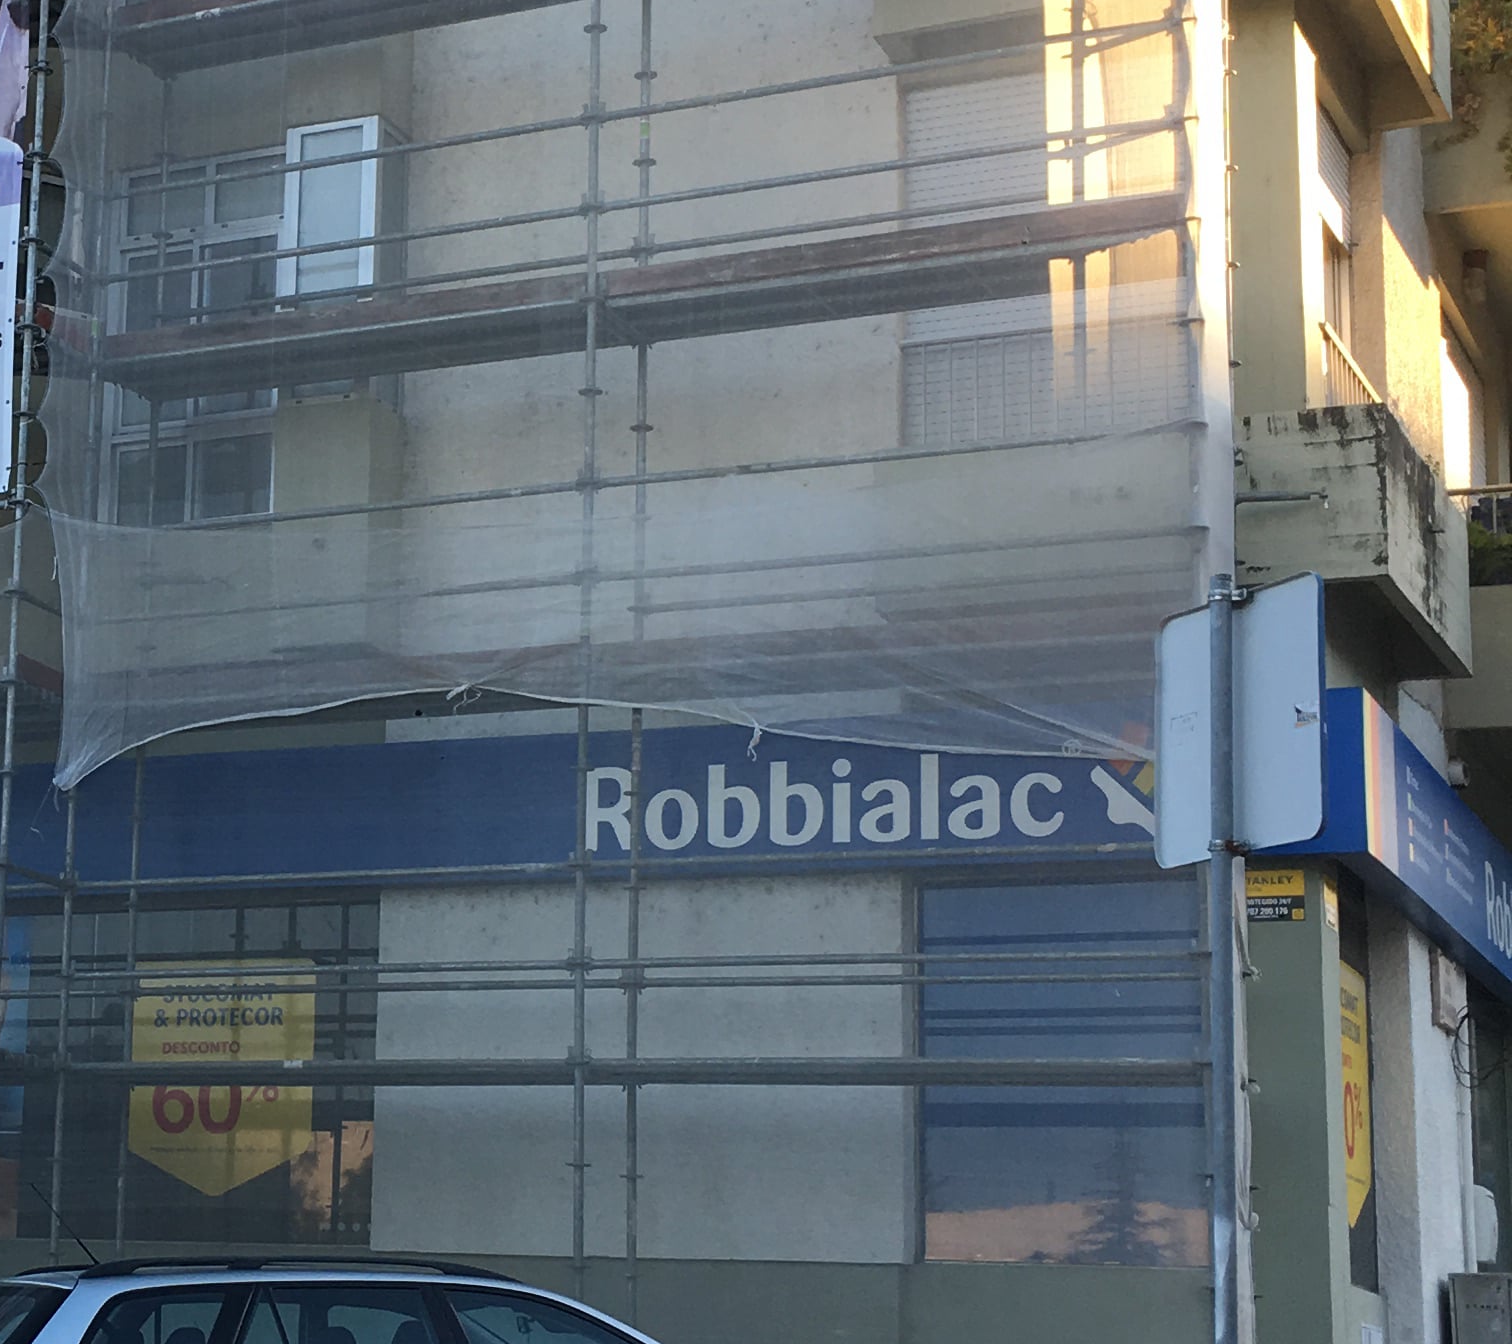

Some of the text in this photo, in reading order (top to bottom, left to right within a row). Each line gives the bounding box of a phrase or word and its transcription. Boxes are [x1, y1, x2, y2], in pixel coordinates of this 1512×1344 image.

[585, 752, 1065, 852] Robbialac
[1245, 875, 1294, 885] TANLEY
[1484, 859, 1512, 960] Rob
[153, 1006, 284, 1028] & PROTECOR
[162, 1040, 241, 1055] DESCONTO
